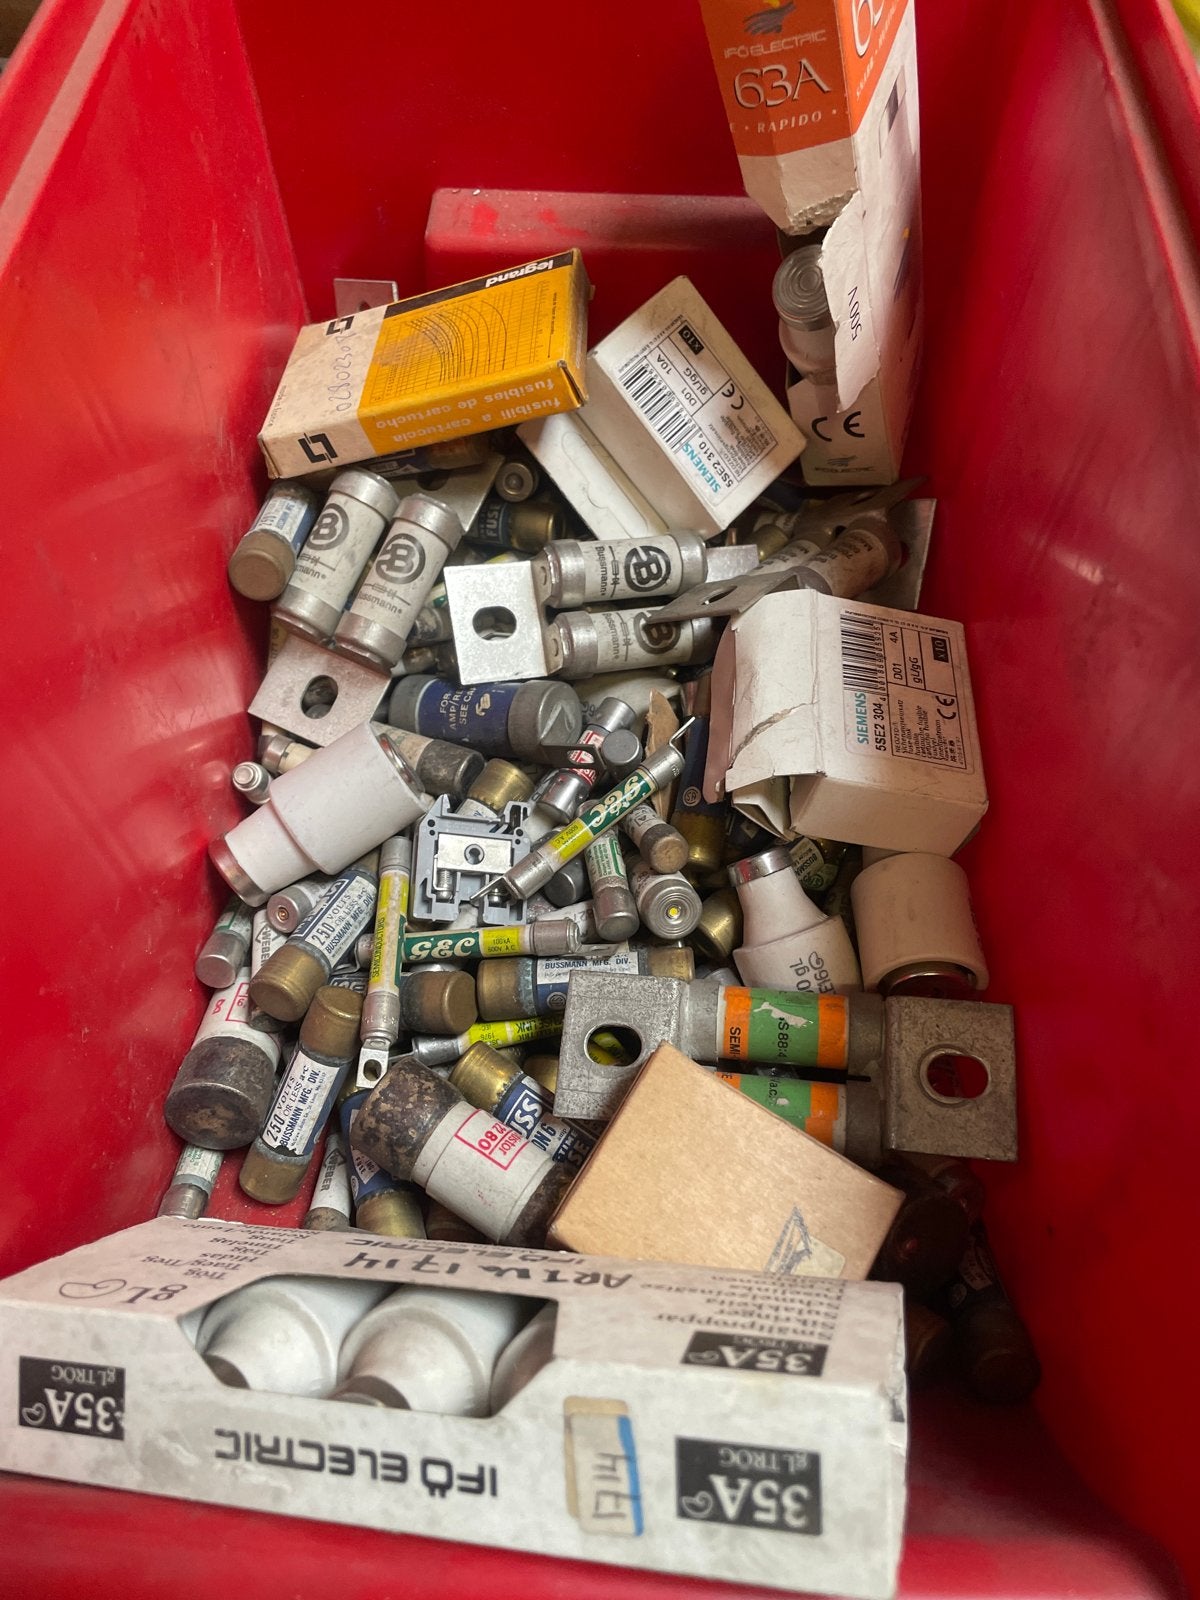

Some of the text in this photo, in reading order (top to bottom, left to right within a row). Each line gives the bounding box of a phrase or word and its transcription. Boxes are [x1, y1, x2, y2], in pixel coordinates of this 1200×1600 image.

[749, 30, 827, 57] ELECTRIC
[733, 58, 831, 109] 63A
[757, 110, 822, 133] RAPIDO
[485, 259, 554, 287] legrand
[654, 353, 697, 406] D01 10A
[376, 378, 554, 429] fusibles de cartucho
[393, 397, 560, 443] fusibili a cartuccia
[698, 440, 715, 460] 310
[681, 442, 722, 493] SIEMENS
[711, 459, 734, 488] 5SE2
[357, 591, 398, 614] ussmann
[889, 632, 903, 680] D01 4A
[909, 657, 923, 683] gL/gG
[439, 692, 452, 715] FOR
[458, 707, 468, 725] SEE
[855, 691, 869, 744] SIEMENS
[873, 703, 887, 751] 5SE2 304
[310, 893, 351, 945] 250 VOLTS
[333, 914, 346, 926] OR
[342, 898, 358, 915] LESS
[324, 920, 352, 953] BUSSMANN
[349, 905, 365, 921] MFG.
[371, 911, 387, 980] SEMICONDUCTORS
[544, 957, 632, 970] BUSSMANN MFG. DIV.
[793, 957, 809, 975] gL
[515, 1020, 536, 1033] LINK
[265, 1075, 294, 1142] 250 VOLTS
[280, 1068, 320, 1146] BUSSMANN MFG. DIV.
[283, 1103, 293, 1116] OR
[289, 1081, 302, 1102] LESS
[507, 1095, 545, 1137] USS
[319, 1152, 339, 1192] WEBER
[142, 1255, 242, 1271] Traeg/Treg
[200, 1252, 258, 1263] Hidas
[343, 1252, 461, 1275] 1714
[345, 1238, 586, 1265] IFÖ ELECTRIC
[129, 1283, 188, 1304] gL
[720, 1344, 813, 1374] 35A
[97, 1367, 117, 1385] gL
[45, 1387, 117, 1435] 35A
[214, 1428, 498, 1498] IFÖ ELECTRIC
[709, 1475, 811, 1529] 35A
